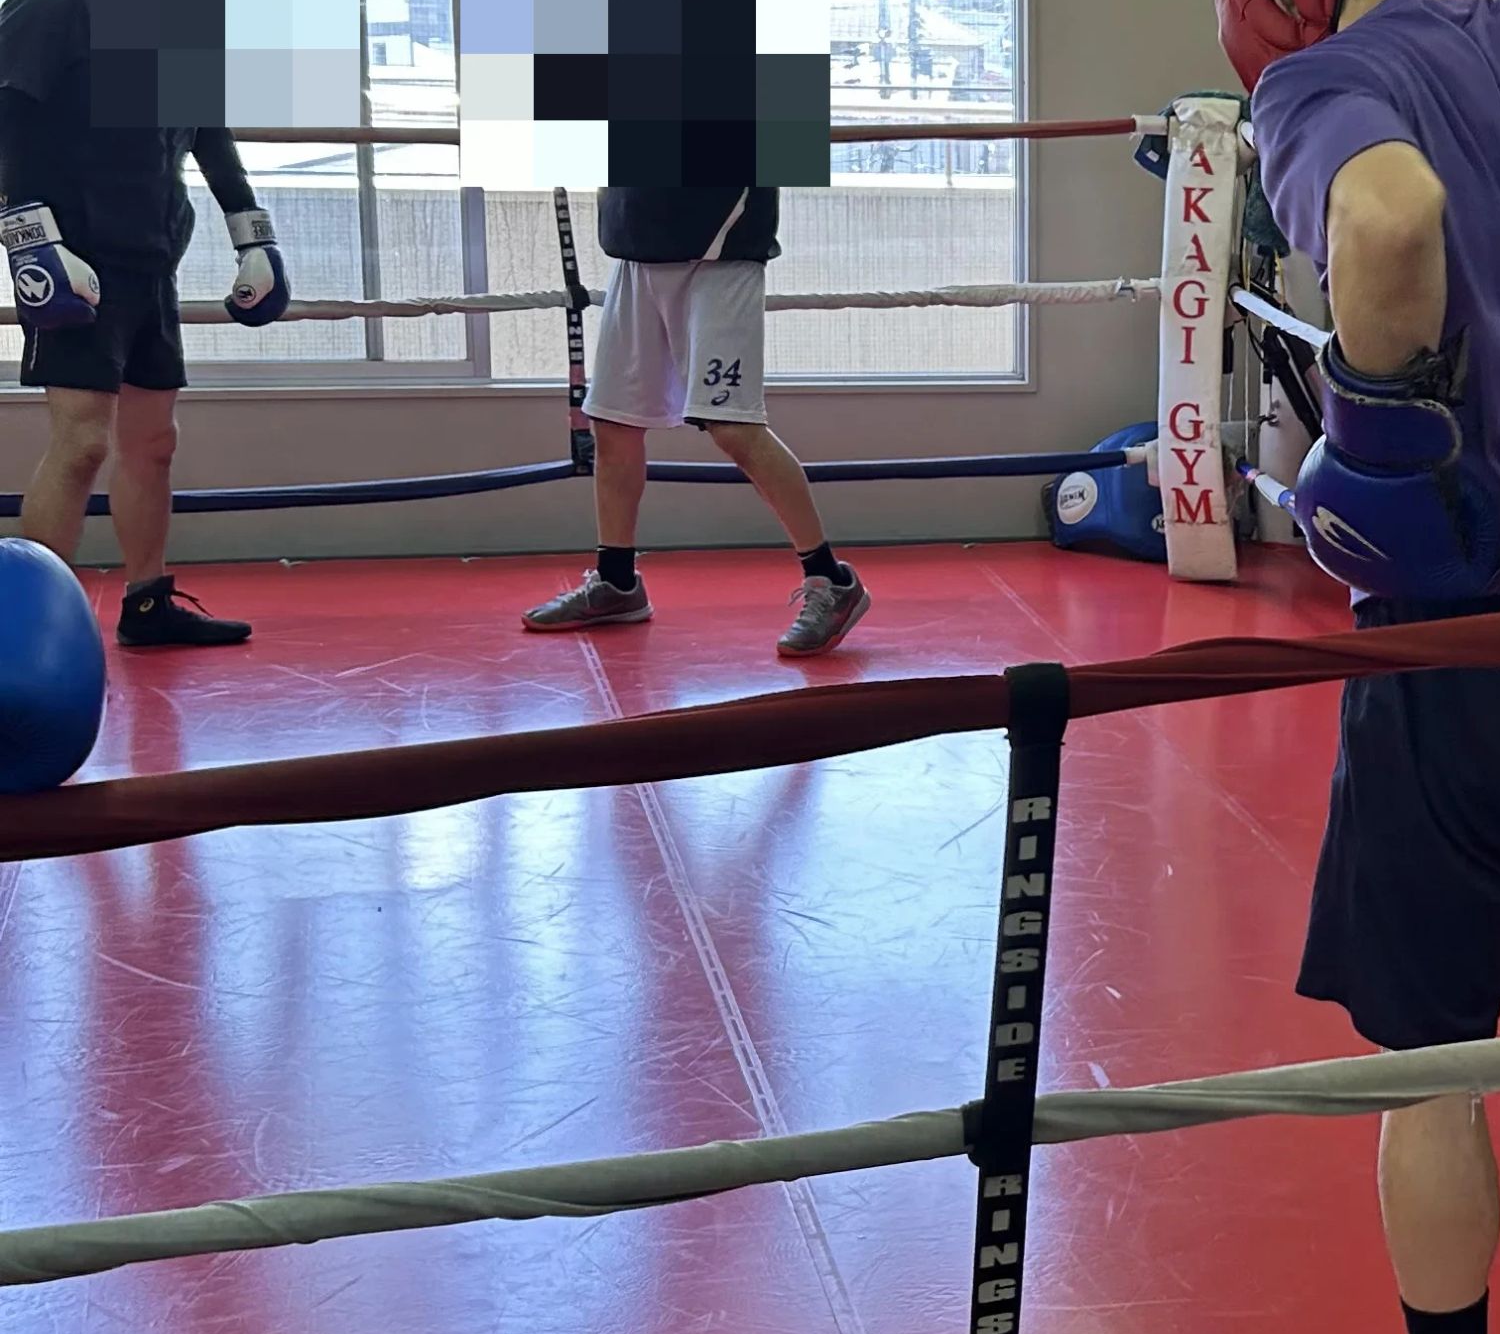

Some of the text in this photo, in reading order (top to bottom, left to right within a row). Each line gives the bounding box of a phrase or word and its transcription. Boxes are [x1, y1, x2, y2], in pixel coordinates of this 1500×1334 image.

[702, 358, 742, 388] 34
[1168, 142, 1218, 526] AKAGI GYM
[995, 795, 1052, 1084] RINGSIDE
